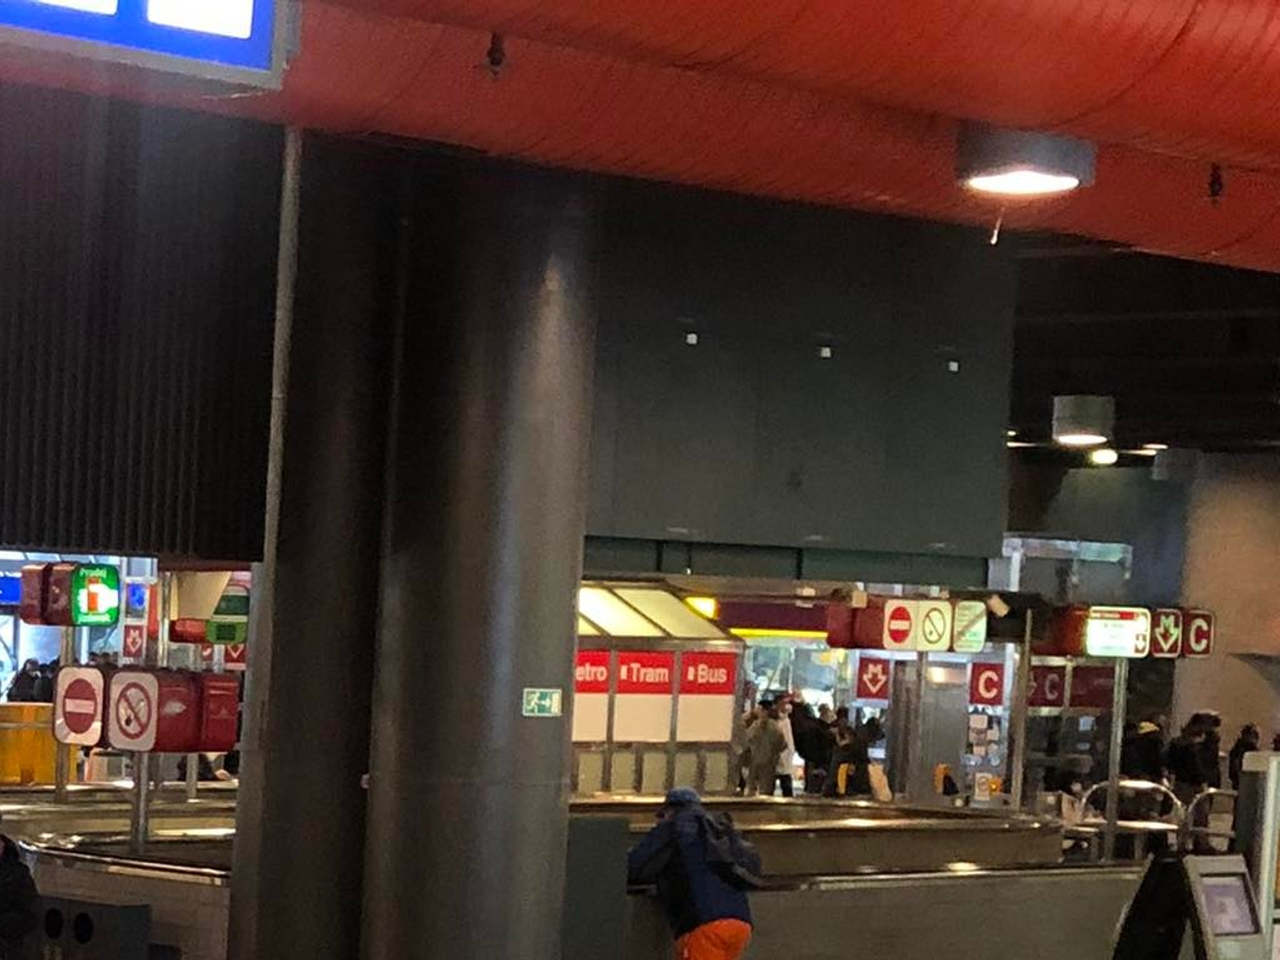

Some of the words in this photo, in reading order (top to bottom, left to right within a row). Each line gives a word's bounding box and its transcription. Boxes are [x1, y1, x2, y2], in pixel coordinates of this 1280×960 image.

[1190, 618, 1209, 652] C
[575, 662, 608, 682] etro
[630, 662, 670, 683] Tram
[697, 663, 728, 684] Bus
[979, 670, 999, 700] C
[1045, 673, 1060, 700] C
